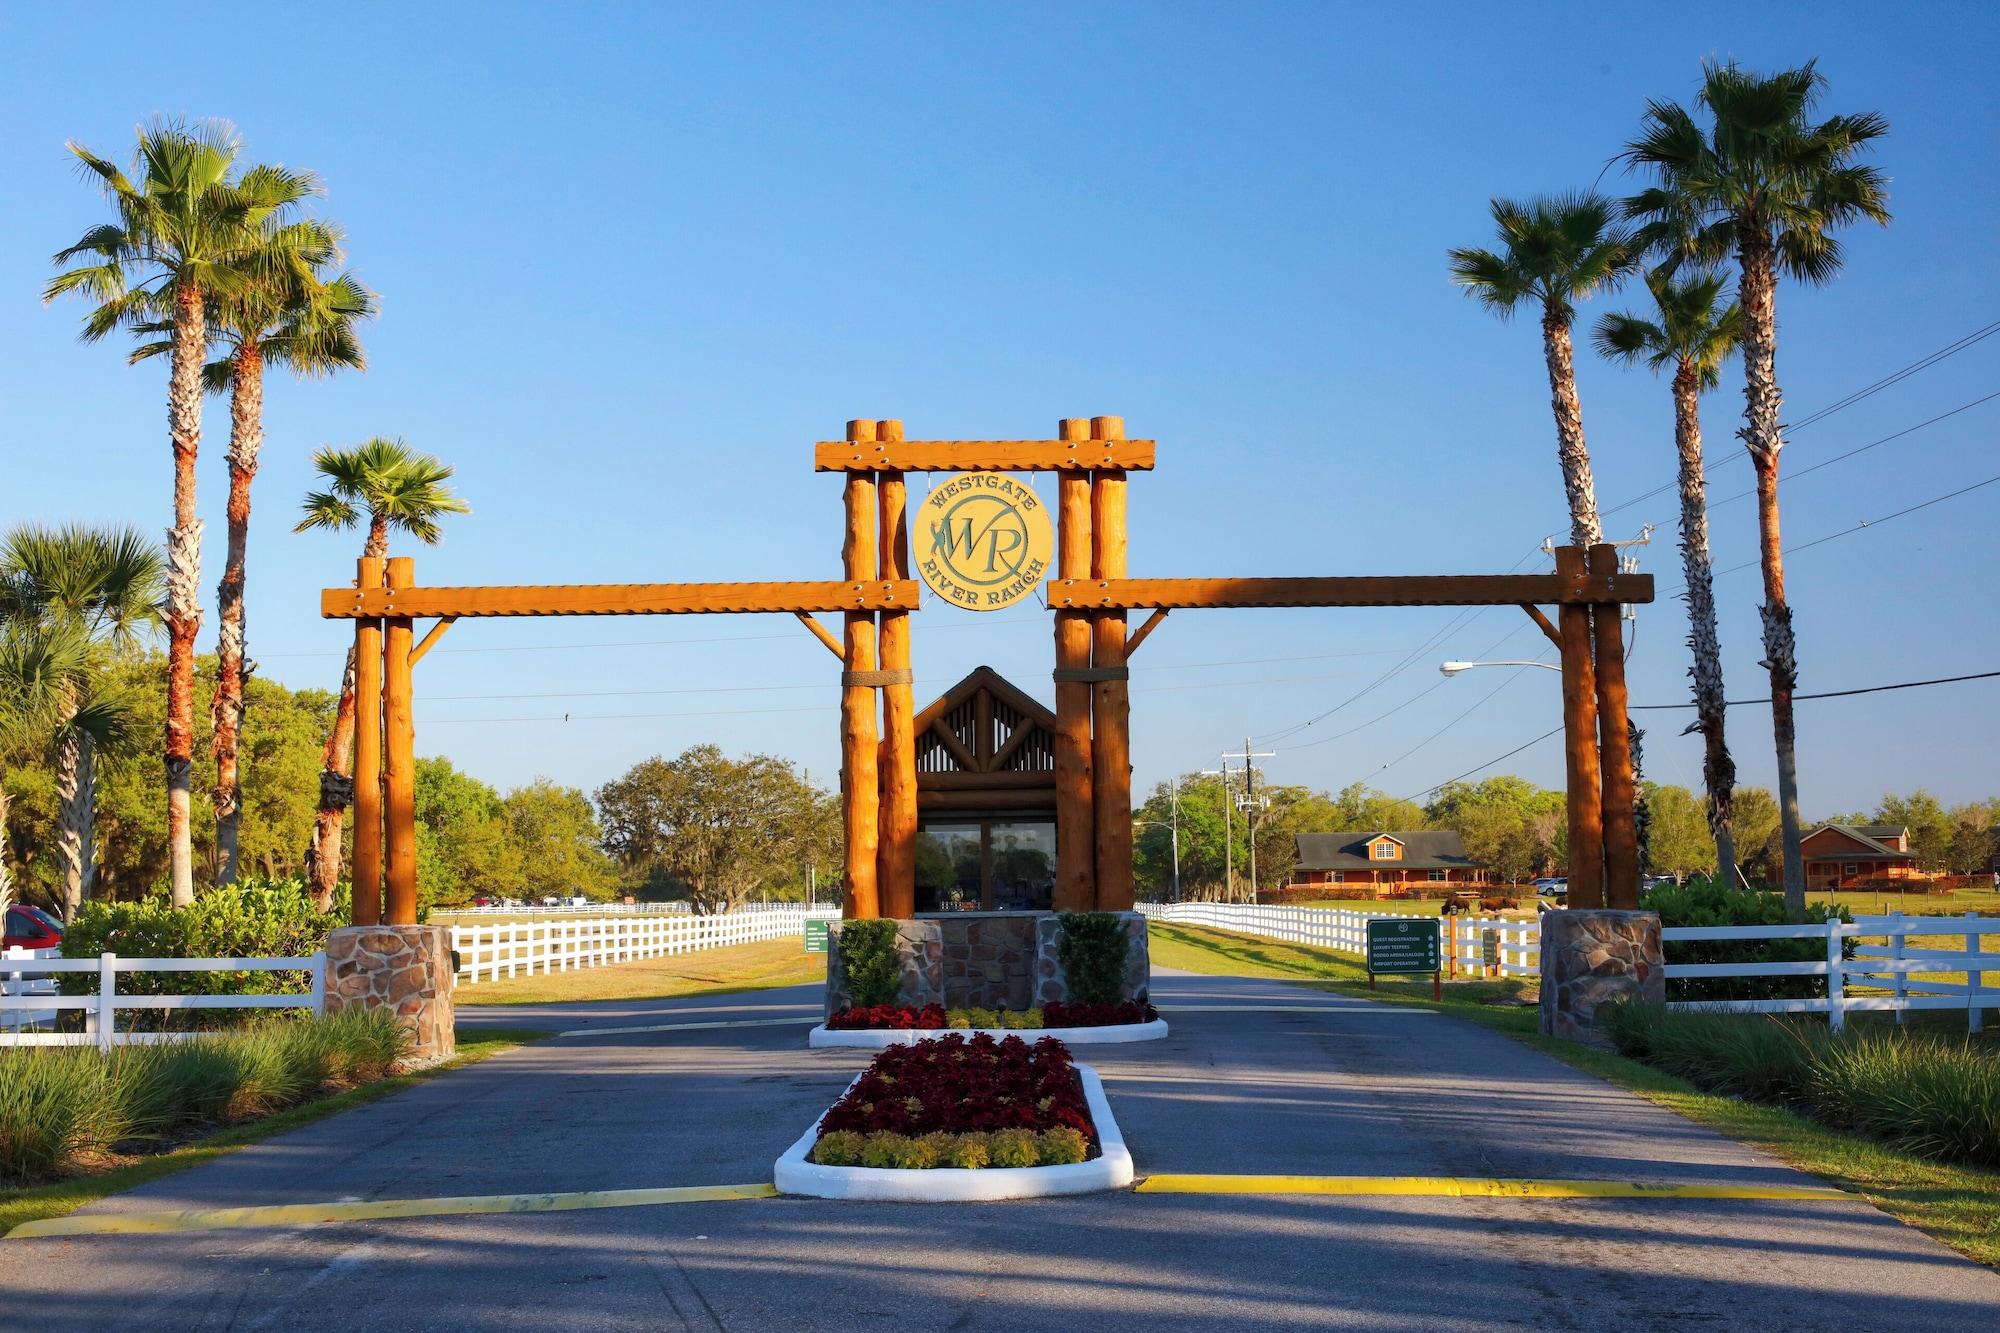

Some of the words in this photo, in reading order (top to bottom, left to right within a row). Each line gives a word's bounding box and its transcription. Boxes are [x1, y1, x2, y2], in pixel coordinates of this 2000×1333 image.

[929, 475, 1037, 512] WESTGATE
[922, 558, 979, 605] RIVER
[986, 558, 1044, 605] RANCH
